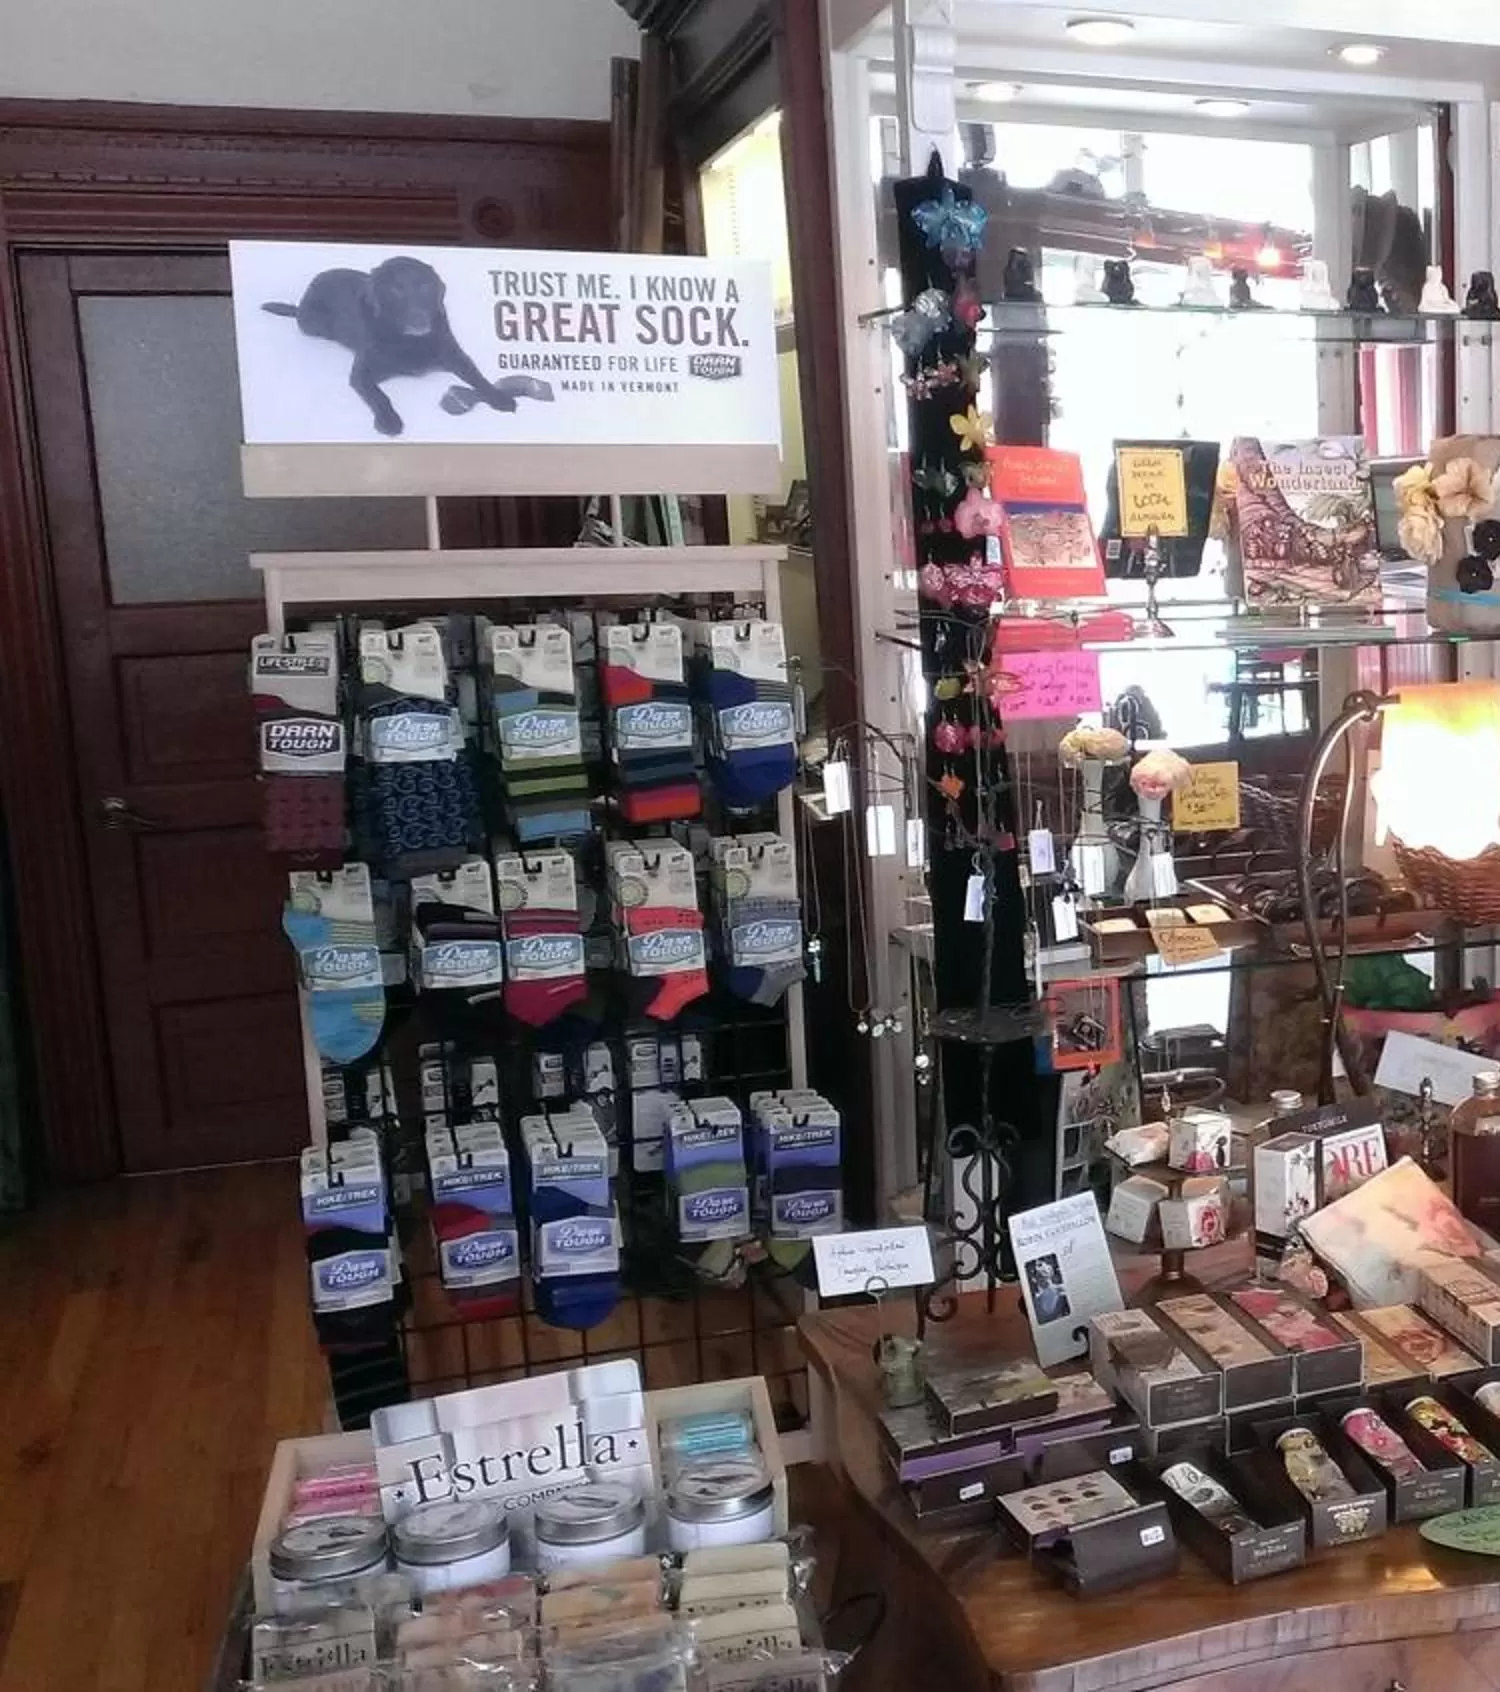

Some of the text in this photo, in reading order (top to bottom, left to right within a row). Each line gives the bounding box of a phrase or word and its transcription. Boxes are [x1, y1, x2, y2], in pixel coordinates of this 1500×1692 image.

[488, 270, 740, 303] TRUST ME. I KNOW A
[493, 300, 749, 347] GREAT SOCK.
[498, 353, 679, 373] GUARANTEED FOR LIFE
[561, 379, 679, 394] MADE IN VERMONT
[269, 724, 335, 738] DARN
[270, 738, 333, 750] TOUGH
[407, 1422, 622, 1505] Estrella
[503, 1476, 592, 1511] COMP
